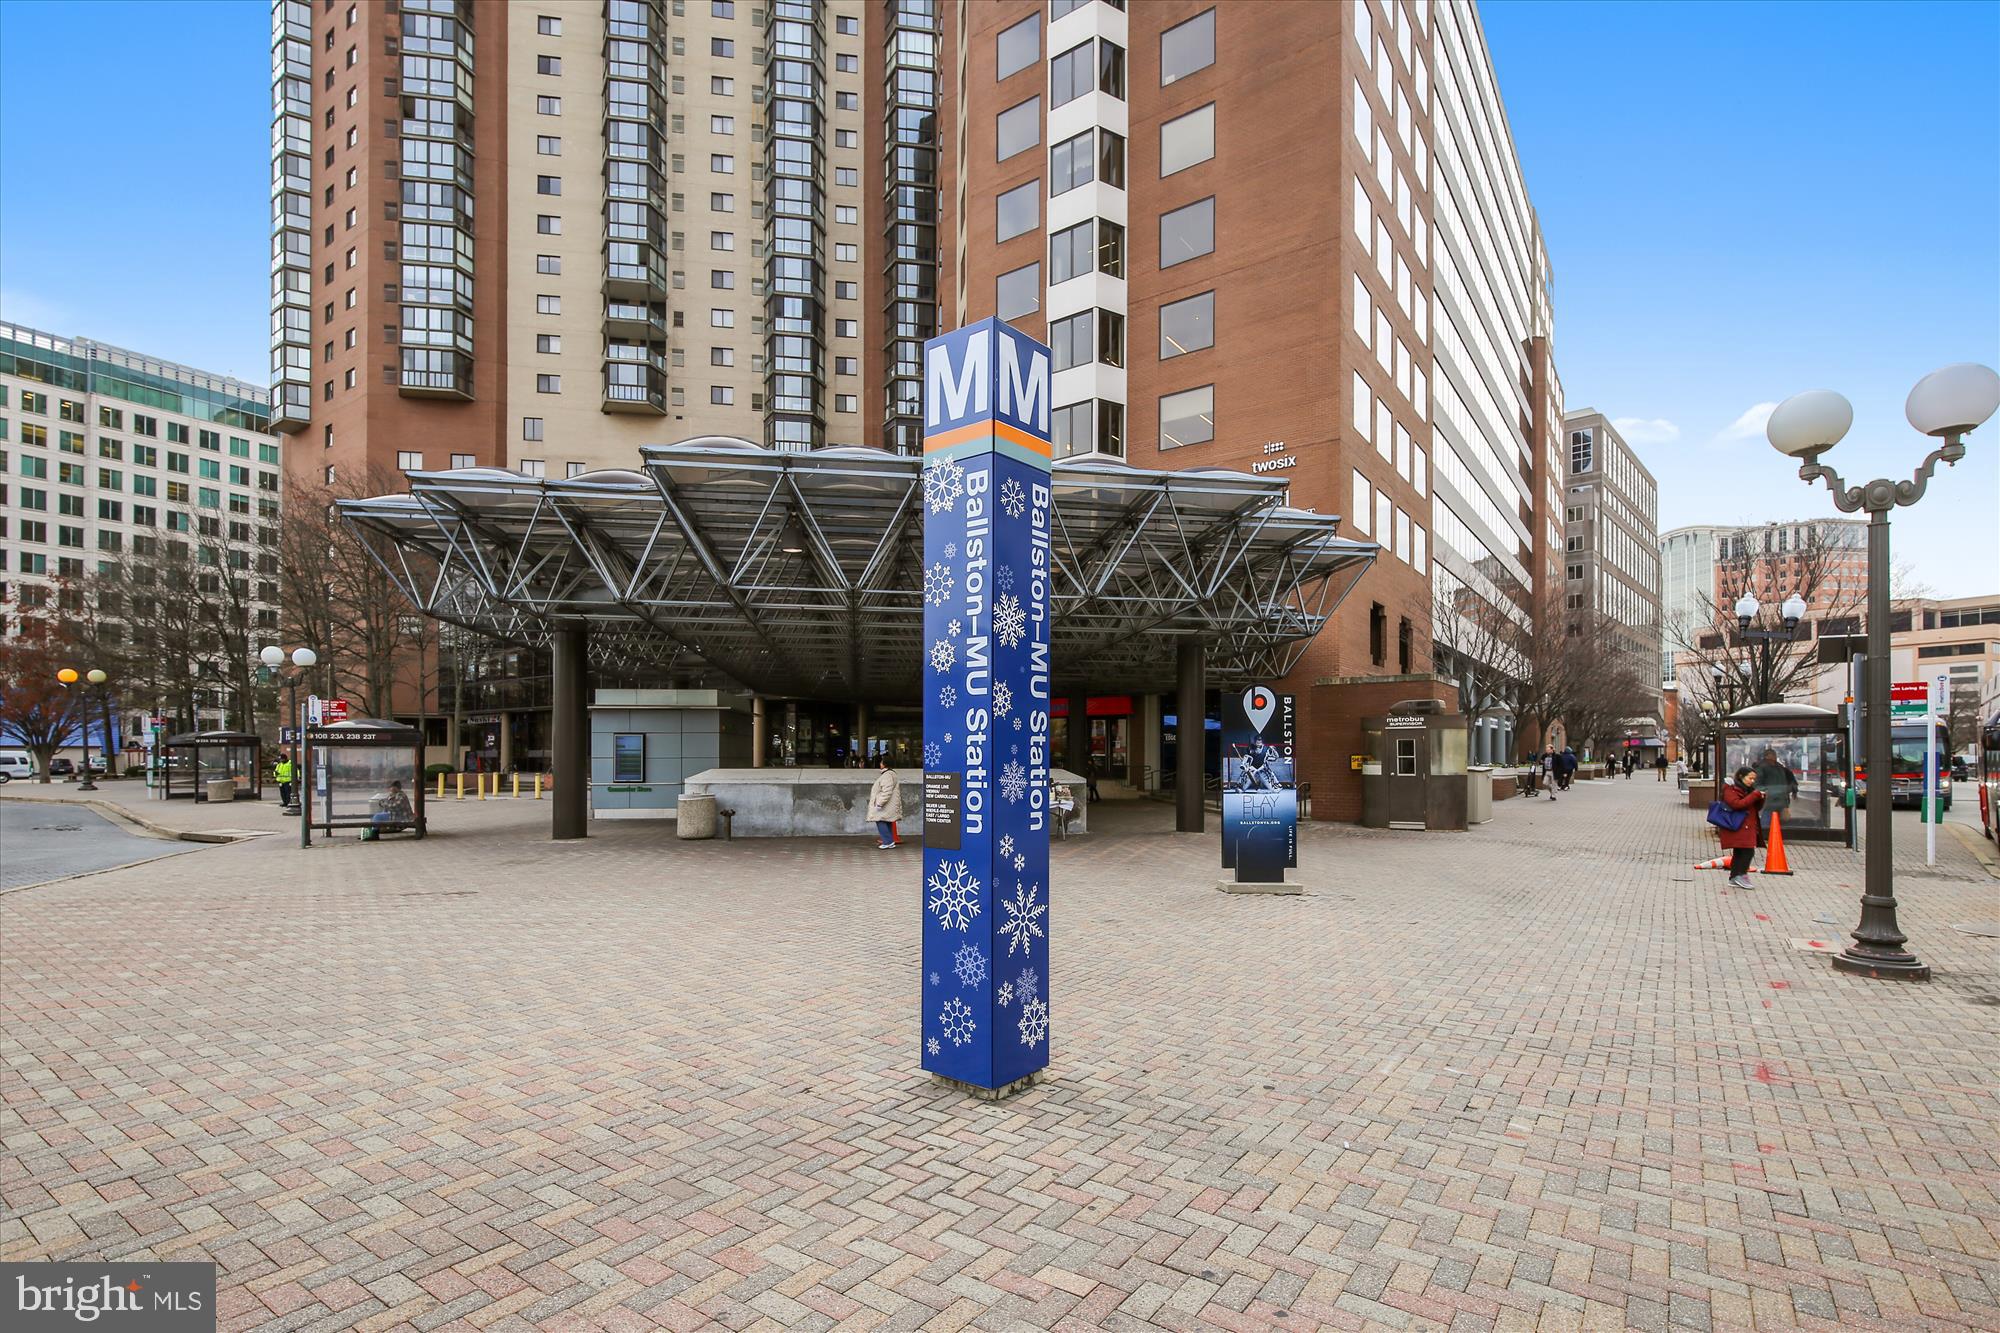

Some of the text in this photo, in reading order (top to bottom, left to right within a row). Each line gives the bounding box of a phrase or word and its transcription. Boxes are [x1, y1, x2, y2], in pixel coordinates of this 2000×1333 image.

[928, 329, 988, 427] M
[999, 331, 1048, 433] M
[1252, 454, 1296, 473] twosix
[966, 708, 988, 833] Station
[1030, 710, 1047, 831] Station
[1284, 697, 1292, 764] BALLSTON
[1243, 795, 1279, 808] PLAY
[1243, 807, 1279, 819] FULL
